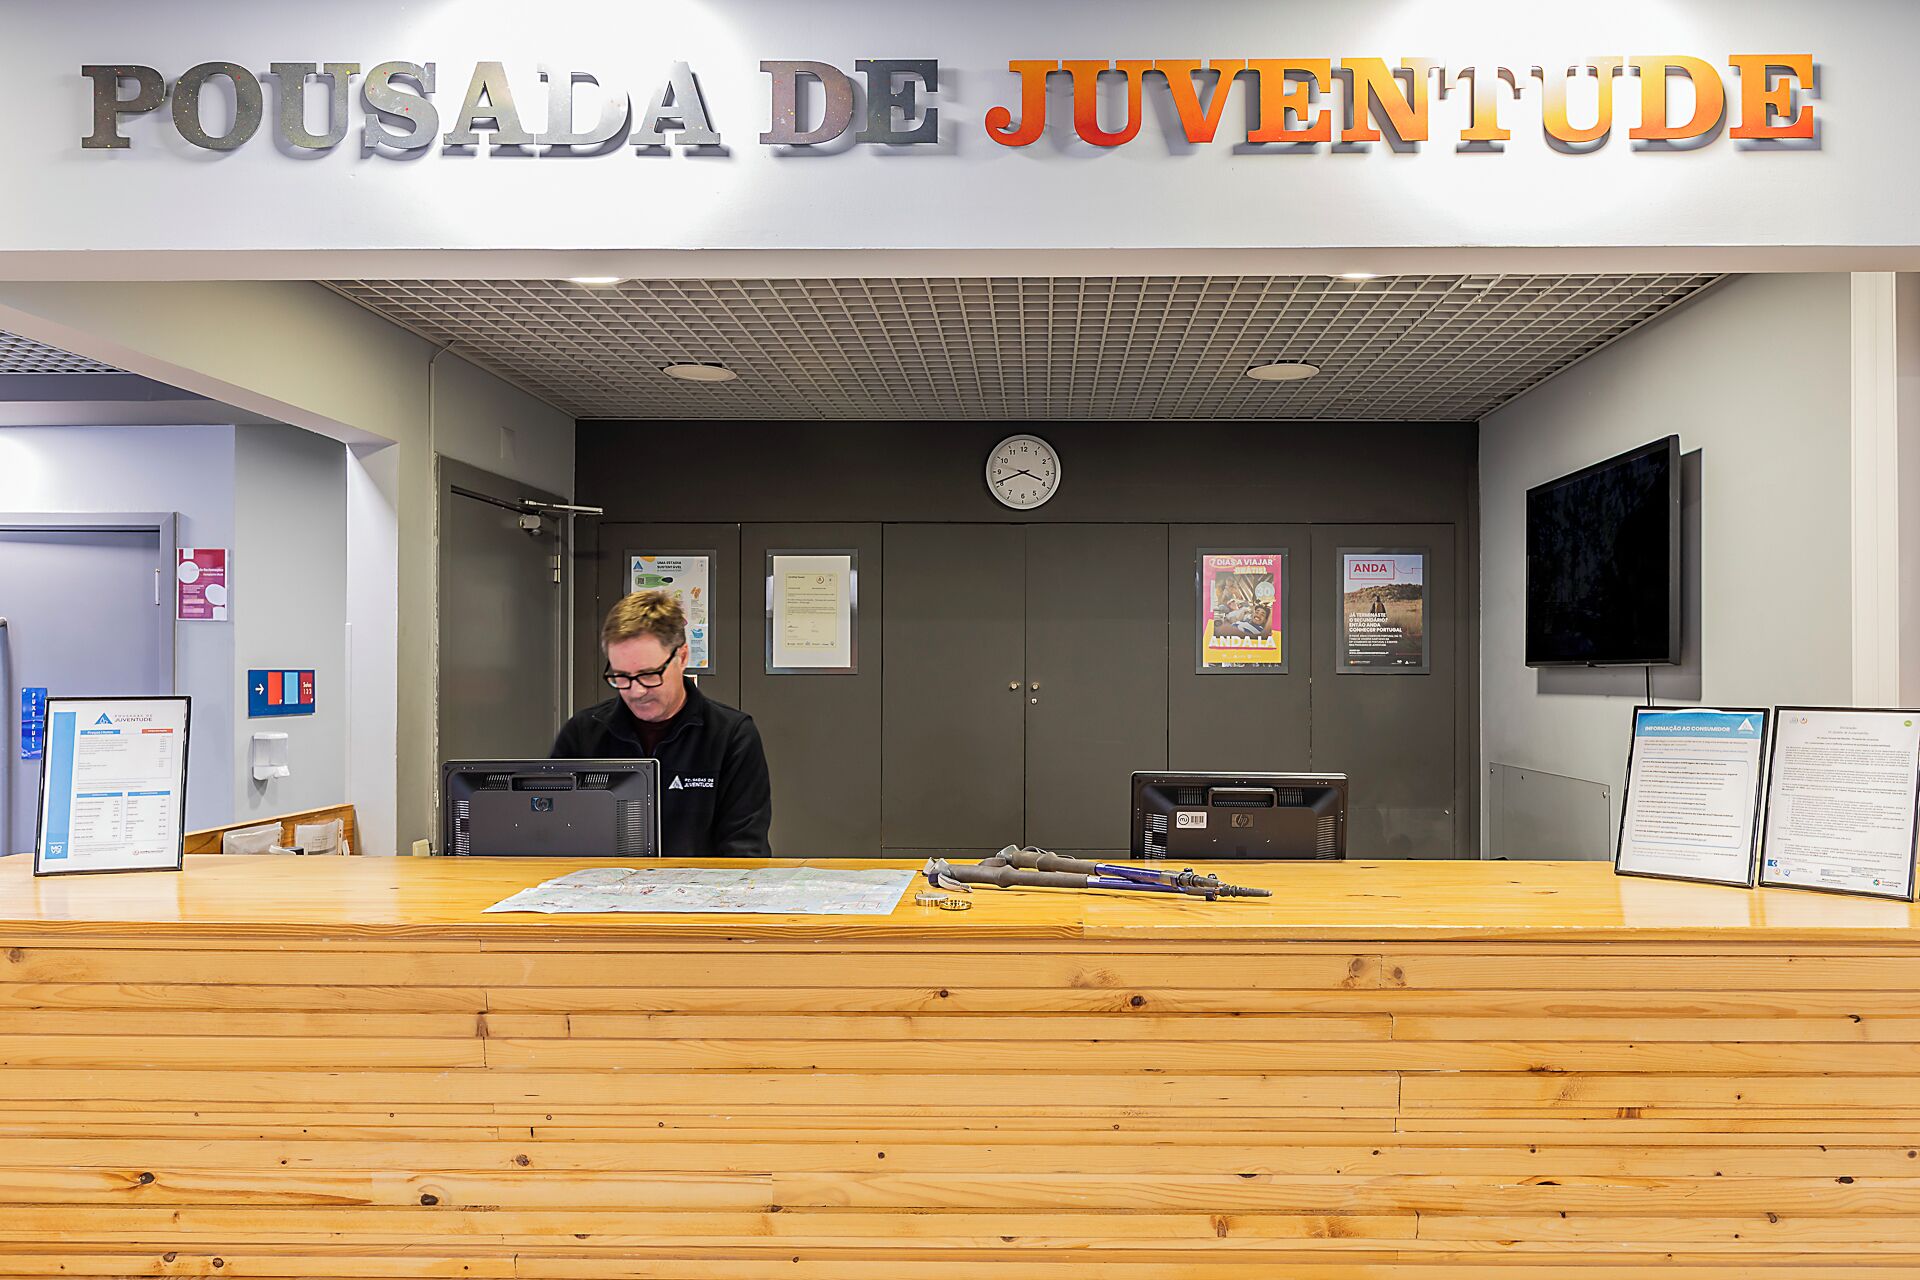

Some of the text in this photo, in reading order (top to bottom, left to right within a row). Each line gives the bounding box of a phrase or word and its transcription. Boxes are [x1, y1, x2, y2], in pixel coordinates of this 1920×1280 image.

[81, 54, 1814, 150] POUSADA DE JUVENTUDE
[1354, 563, 1387, 573] ANDA
